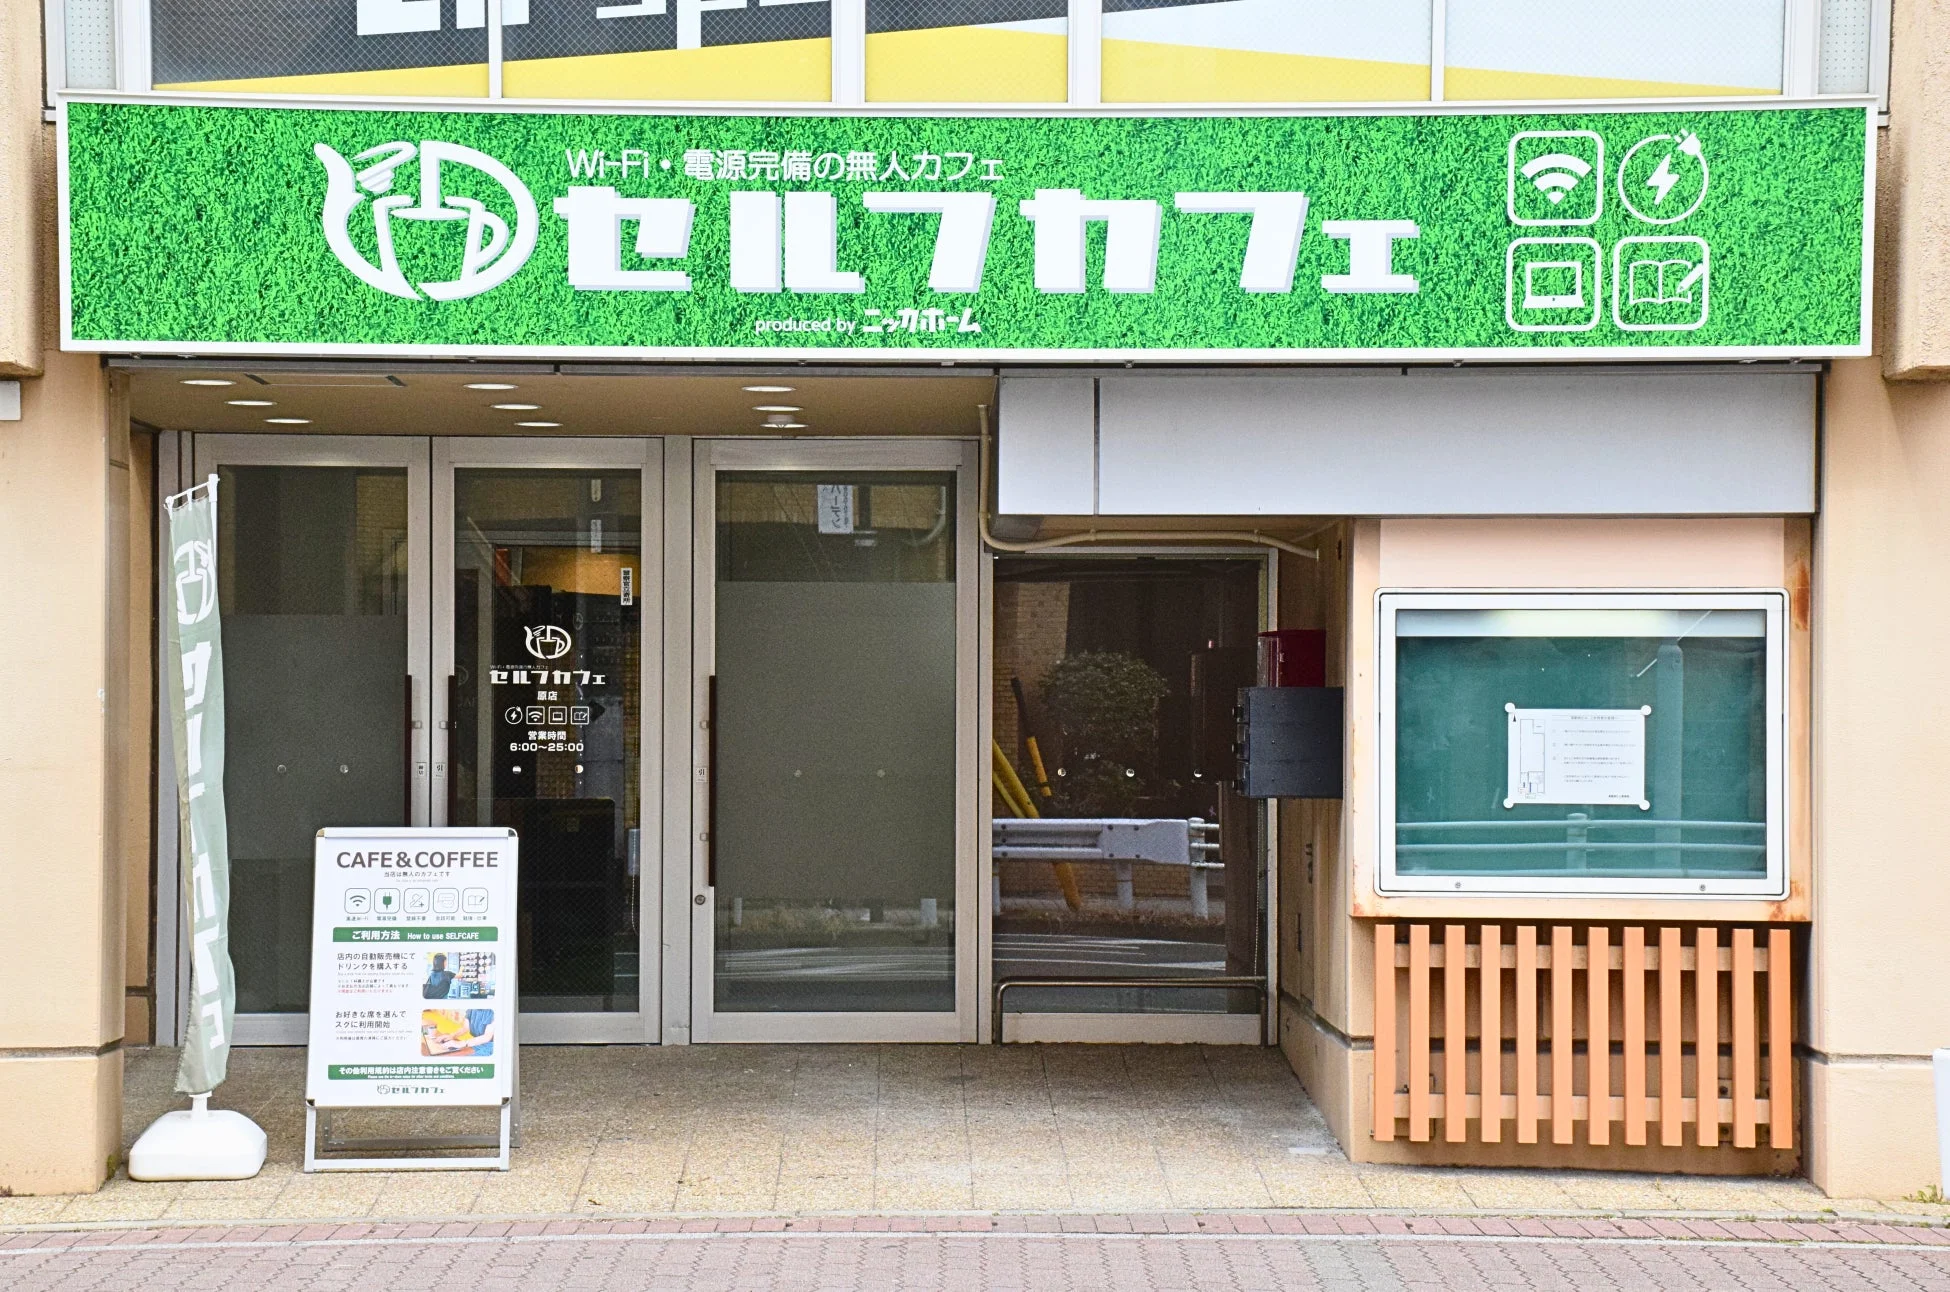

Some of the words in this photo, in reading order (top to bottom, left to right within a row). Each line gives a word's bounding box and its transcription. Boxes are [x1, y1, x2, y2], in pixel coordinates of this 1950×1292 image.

[553, 186, 1420, 294] セルフカフェ
[755, 316, 831, 335] produced
[837, 316, 856, 336] by
[862, 307, 982, 333] ニッカホーム
[489, 670, 606, 685] セルフカフェ
[537, 690, 558, 701] 原店
[527, 730, 567, 741] 営業時間
[351, 930, 400, 940] ご利用方法
[407, 932, 421, 940] How
[423, 932, 431, 940] to
[445, 932, 480, 940] SELFCAFE
[336, 952, 416, 961] 店内の自動販売機にて
[337, 962, 408, 971] ドリンクを購入する
[335, 1010, 407, 1019] お好きな席を選んで
[335, 1020, 391, 1029] スグに利用開始
[391, 1086, 445, 1094] セルフカフェ
